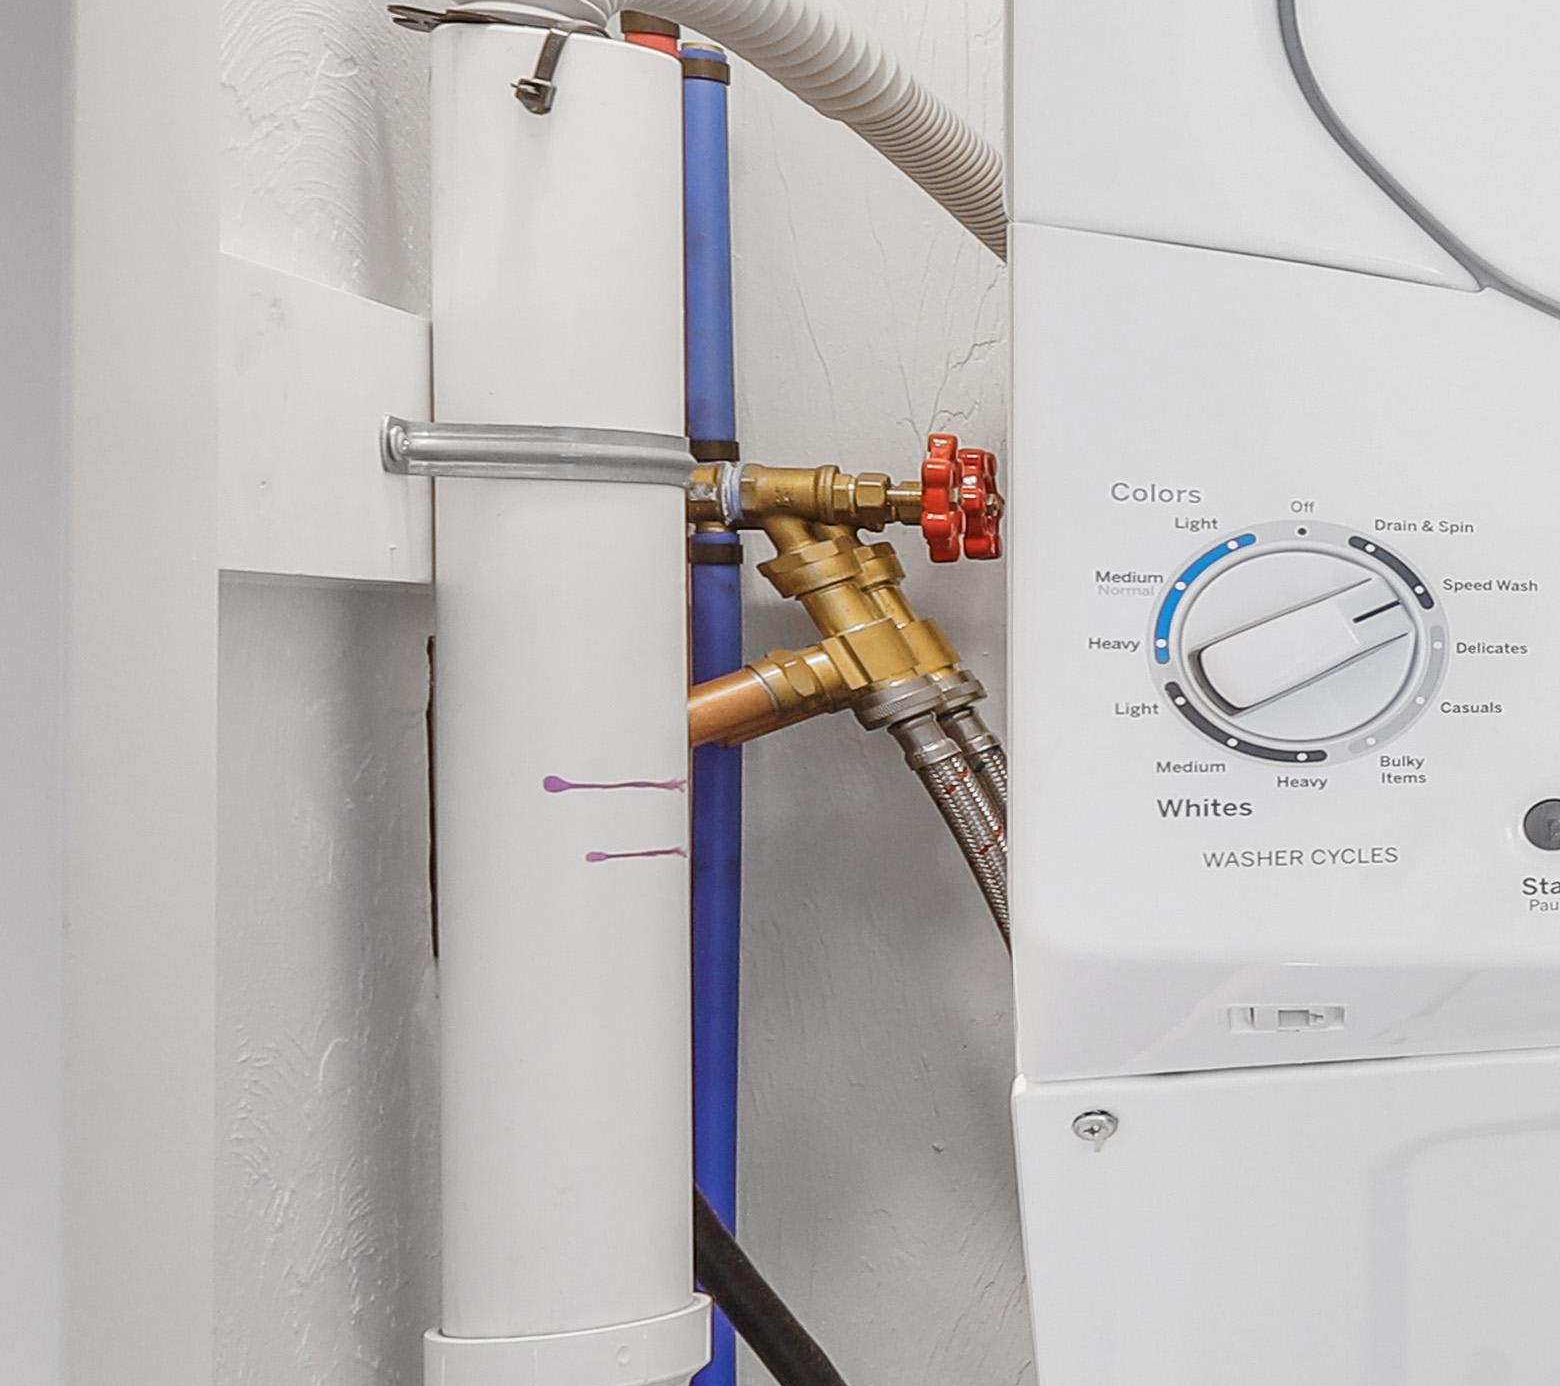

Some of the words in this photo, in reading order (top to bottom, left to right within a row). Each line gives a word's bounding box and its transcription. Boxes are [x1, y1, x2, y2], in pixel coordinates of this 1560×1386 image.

[1110, 482, 1202, 504] Colors
[1290, 500, 1314, 513] Off
[1175, 516, 1218, 532] Light
[1374, 519, 1415, 532] Drain
[1420, 520, 1434, 532] &
[1438, 521, 1474, 535] Spin
[1096, 571, 1163, 584] Medium
[1097, 585, 1155, 597] Normal
[1443, 579, 1493, 593] Speed
[1496, 580, 1538, 592] Wash
[1089, 637, 1140, 653] Heavy
[1456, 641, 1527, 655] Delicates
[1115, 702, 1159, 717] Light
[1440, 701, 1503, 714] Casuals
[1156, 761, 1226, 773] Medium
[1380, 755, 1424, 770] Bulky
[1277, 776, 1328, 791] Heavy
[1381, 772, 1426, 785] Items
[1157, 798, 1252, 818] Whites
[1203, 851, 1303, 868] WASHER
[1311, 847, 1398, 865] CYCLES
